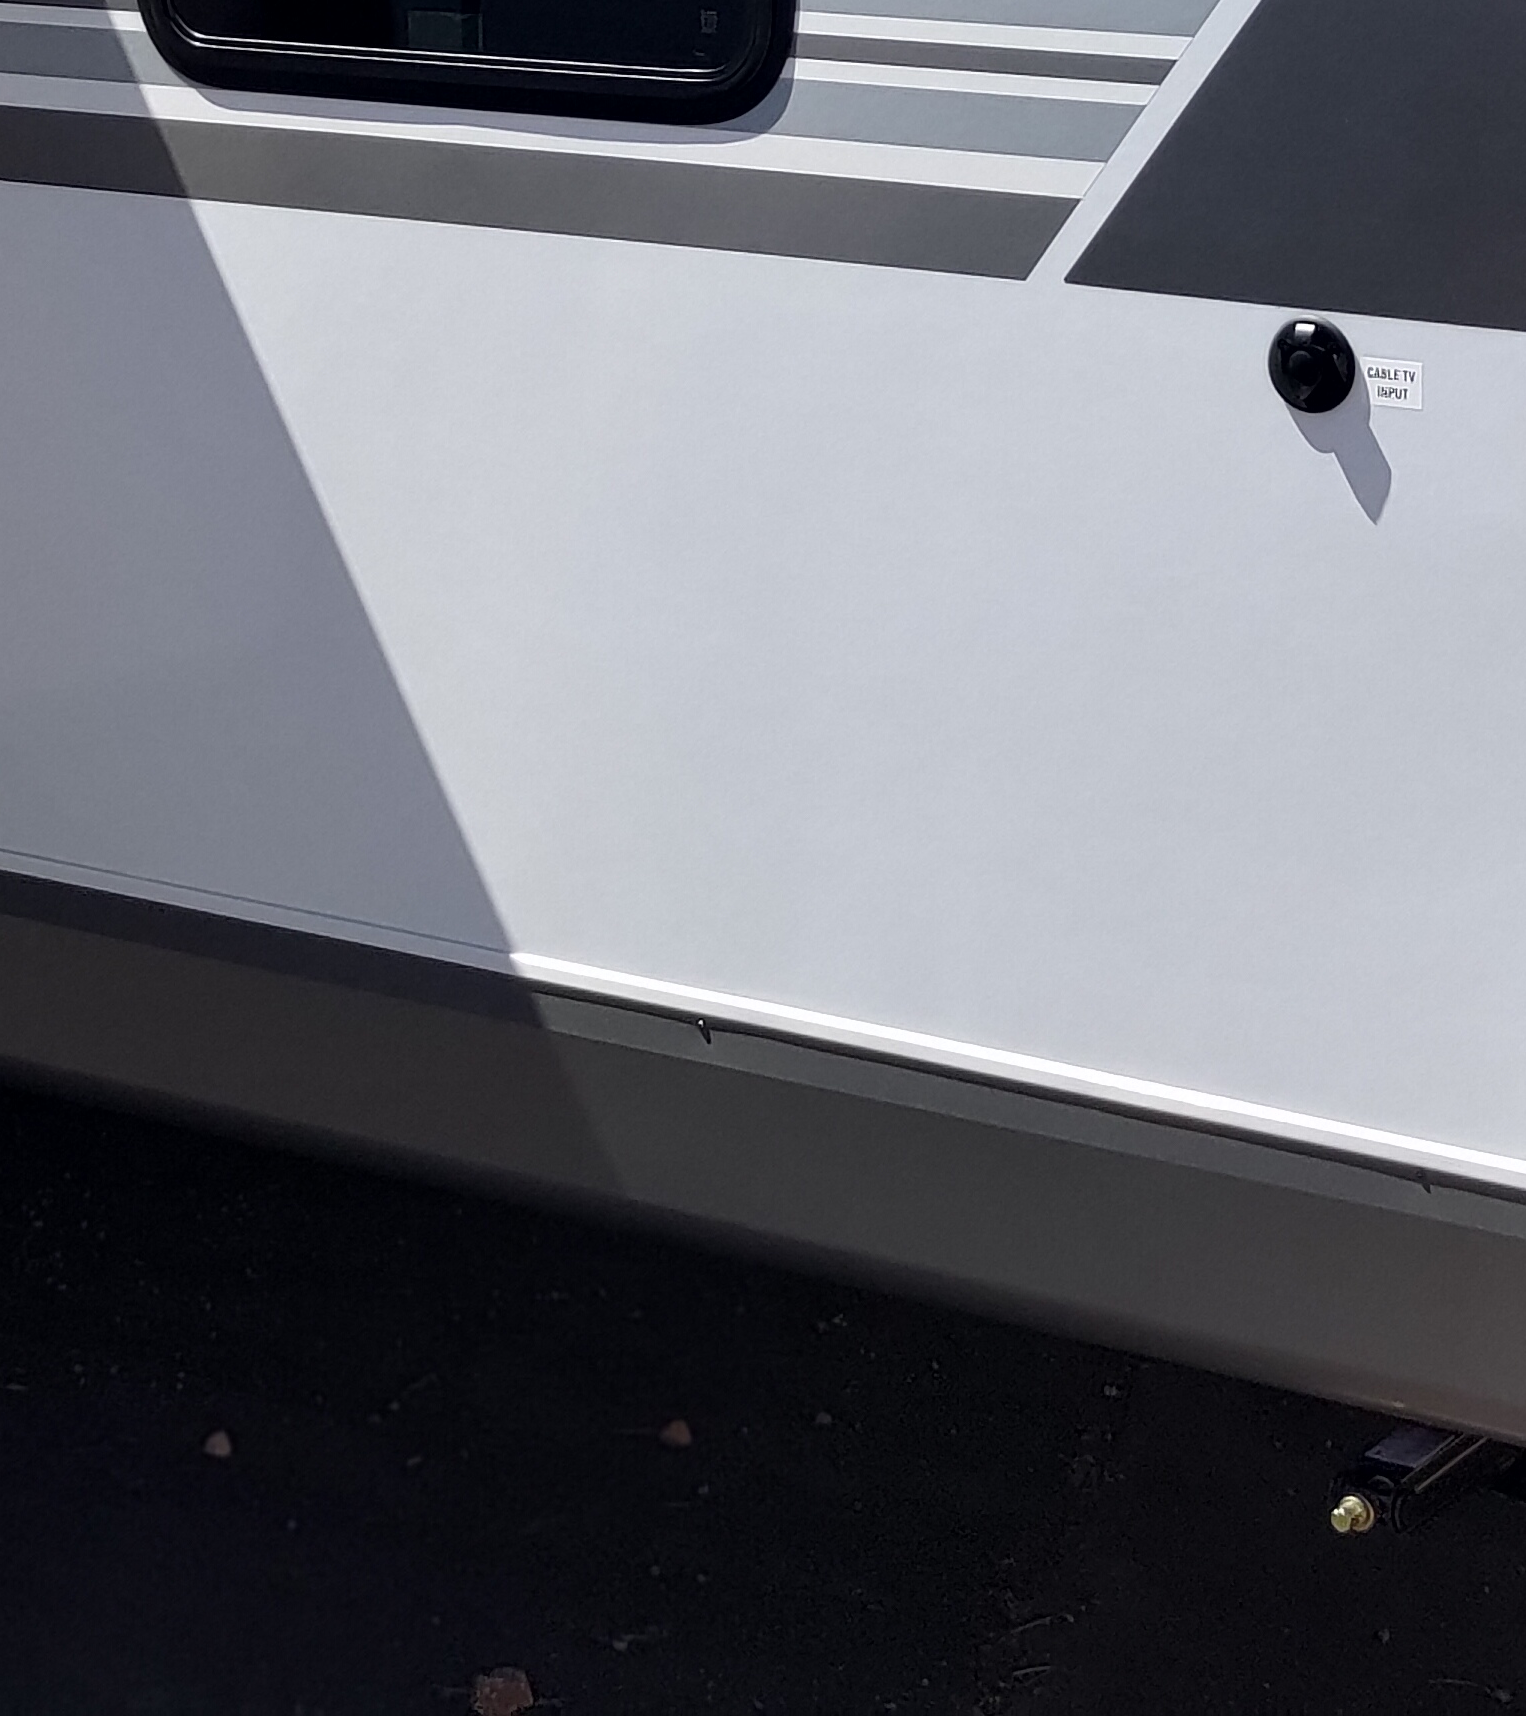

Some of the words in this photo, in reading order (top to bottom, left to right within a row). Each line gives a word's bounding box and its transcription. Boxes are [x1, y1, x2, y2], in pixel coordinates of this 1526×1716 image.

[1366, 366, 1400, 381] CABLE
[1402, 369, 1416, 383] TV
[1377, 385, 1408, 400] INPUT
